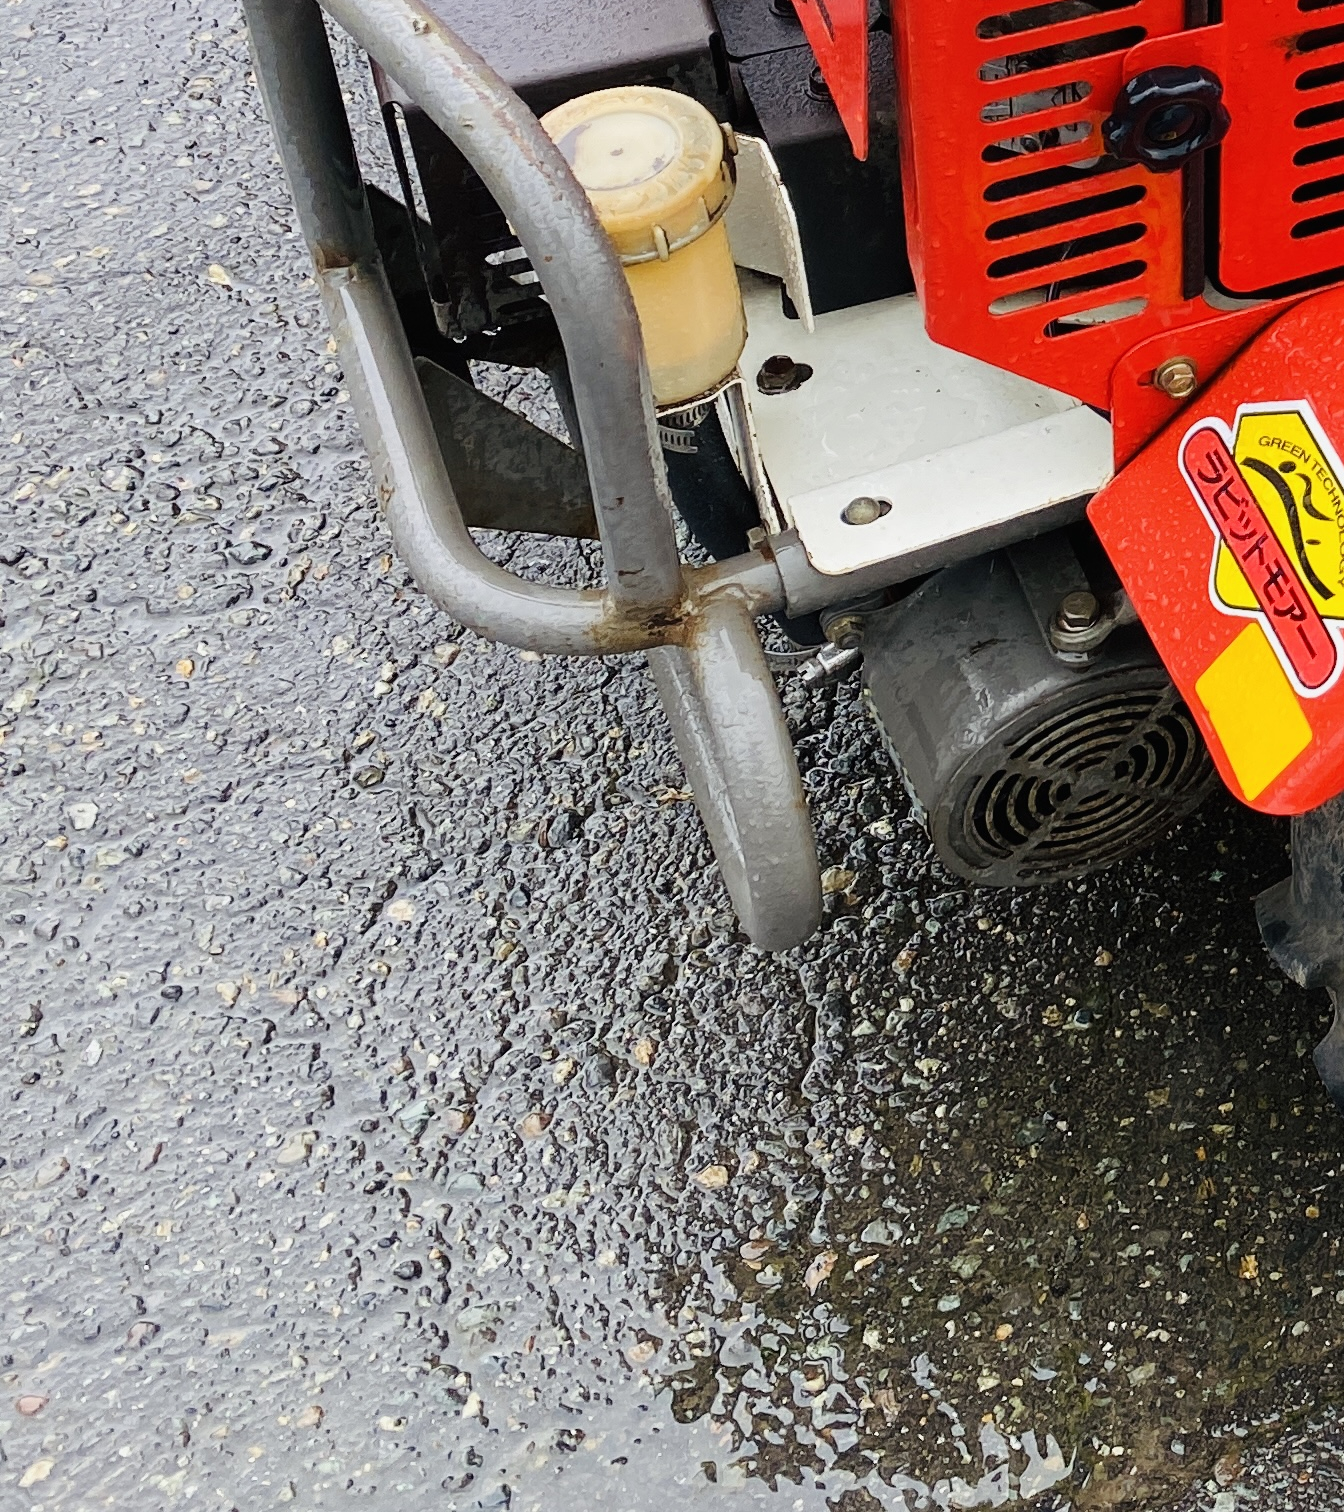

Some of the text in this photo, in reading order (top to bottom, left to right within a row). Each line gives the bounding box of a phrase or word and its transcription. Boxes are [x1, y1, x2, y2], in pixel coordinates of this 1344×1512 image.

[1257, 434, 1312, 464] GREEN
[1196, 448, 1318, 660] ラビットモアー
